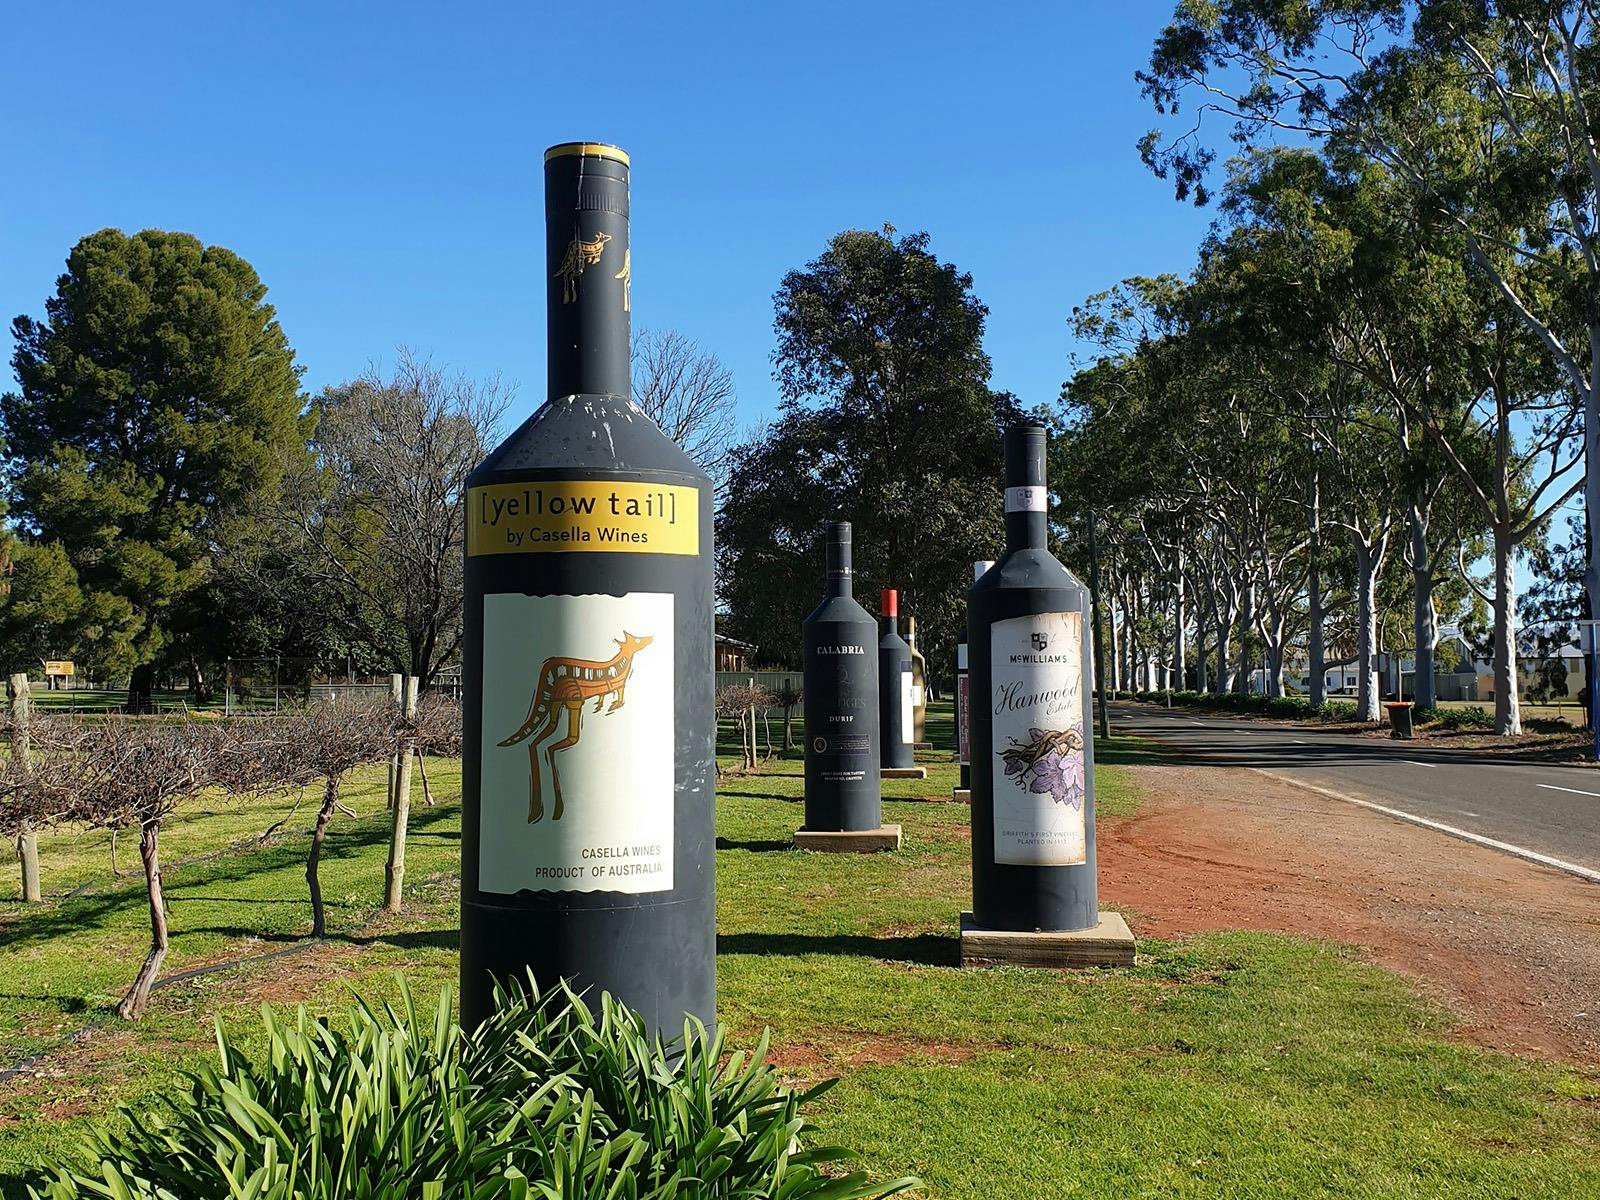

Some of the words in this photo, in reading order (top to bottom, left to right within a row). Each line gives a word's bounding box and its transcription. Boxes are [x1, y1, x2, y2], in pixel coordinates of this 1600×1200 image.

[482, 490, 596, 525] [yellow
[608, 492, 675, 524] tail]
[506, 528, 524, 546] by
[529, 527, 591, 542] Casella
[597, 528, 648, 543] Wines
[817, 645, 865, 655] CALABRIA
[994, 673, 1081, 716] Hanwood
[1046, 700, 1072, 716] Estate
[581, 847, 629, 859] CASELLA
[632, 845, 662, 856] WINES
[535, 866, 585, 878] PRODUCT
[591, 866, 606, 877] OF
[608, 862, 663, 877] AUSTRALIA
